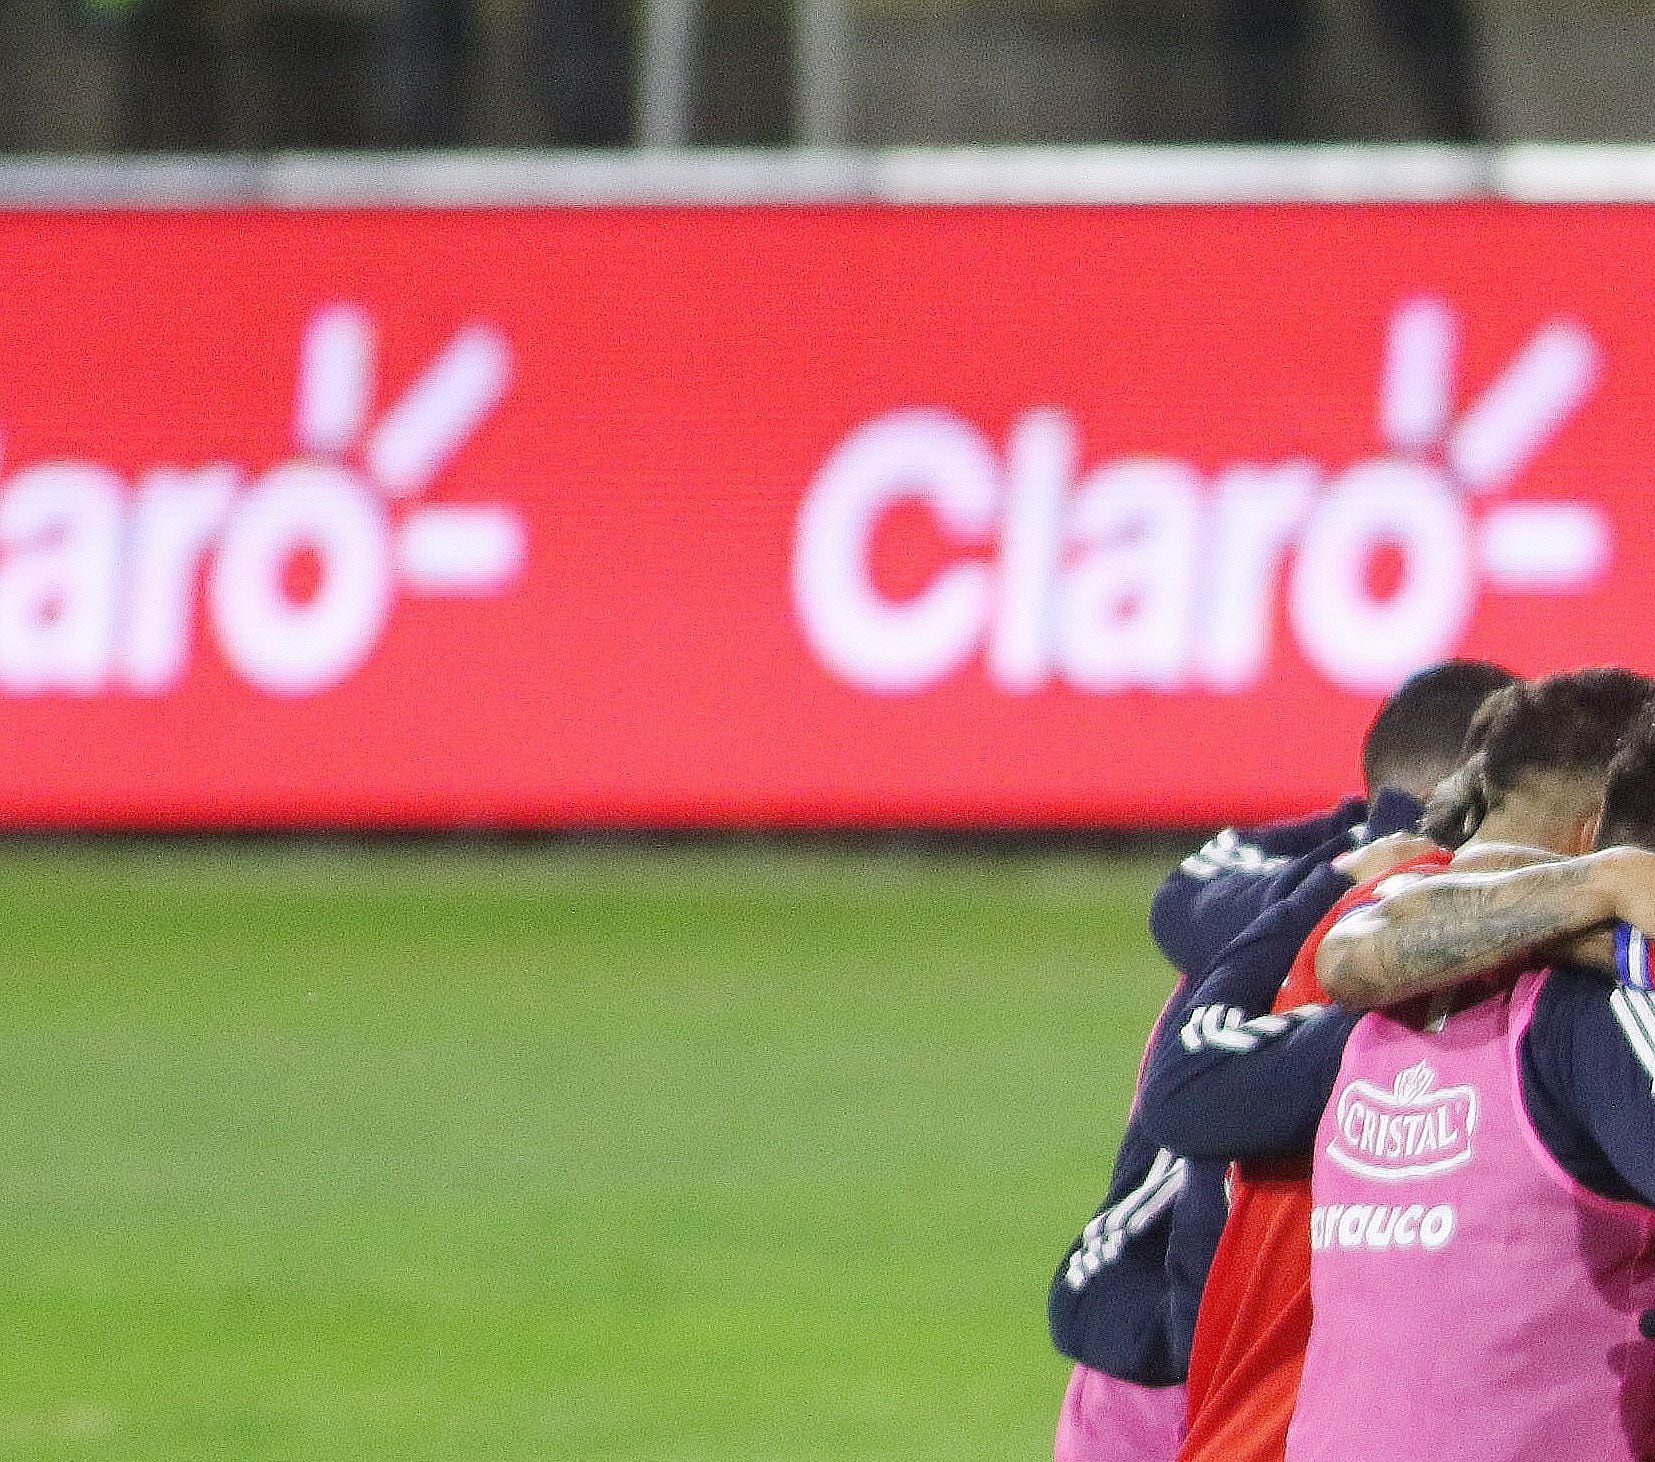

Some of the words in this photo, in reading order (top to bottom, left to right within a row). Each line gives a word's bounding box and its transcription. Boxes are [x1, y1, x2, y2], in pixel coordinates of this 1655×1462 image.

[790, 406, 1480, 693] Claro
[1343, 1102, 1458, 1158] CRISTAL
[1311, 1203, 1455, 1250] arauco
